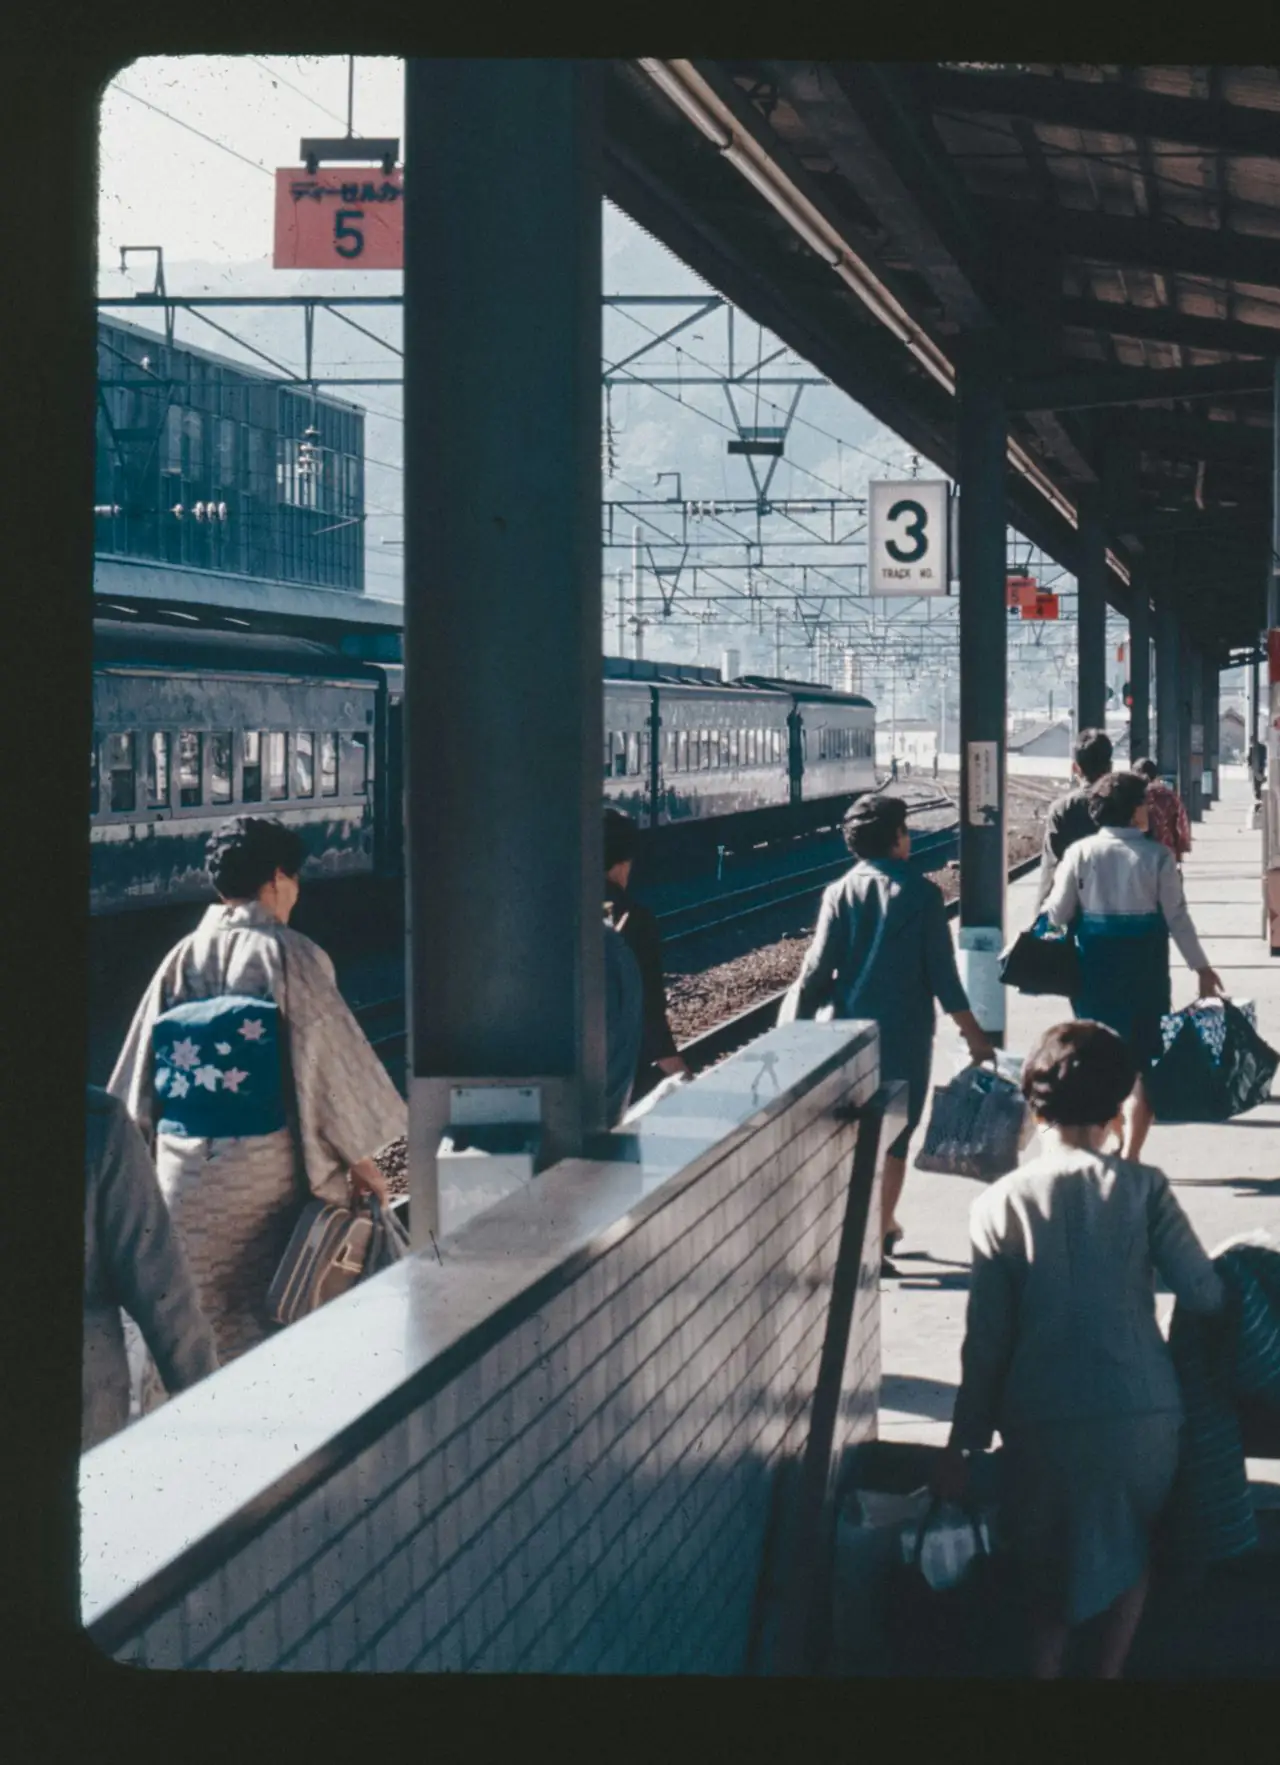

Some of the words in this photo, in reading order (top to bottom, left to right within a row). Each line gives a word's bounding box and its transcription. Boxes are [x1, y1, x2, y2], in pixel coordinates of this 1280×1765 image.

[334, 208, 365, 259] 5
[885, 499, 929, 563] 3
[881, 568, 912, 580] TRACK
